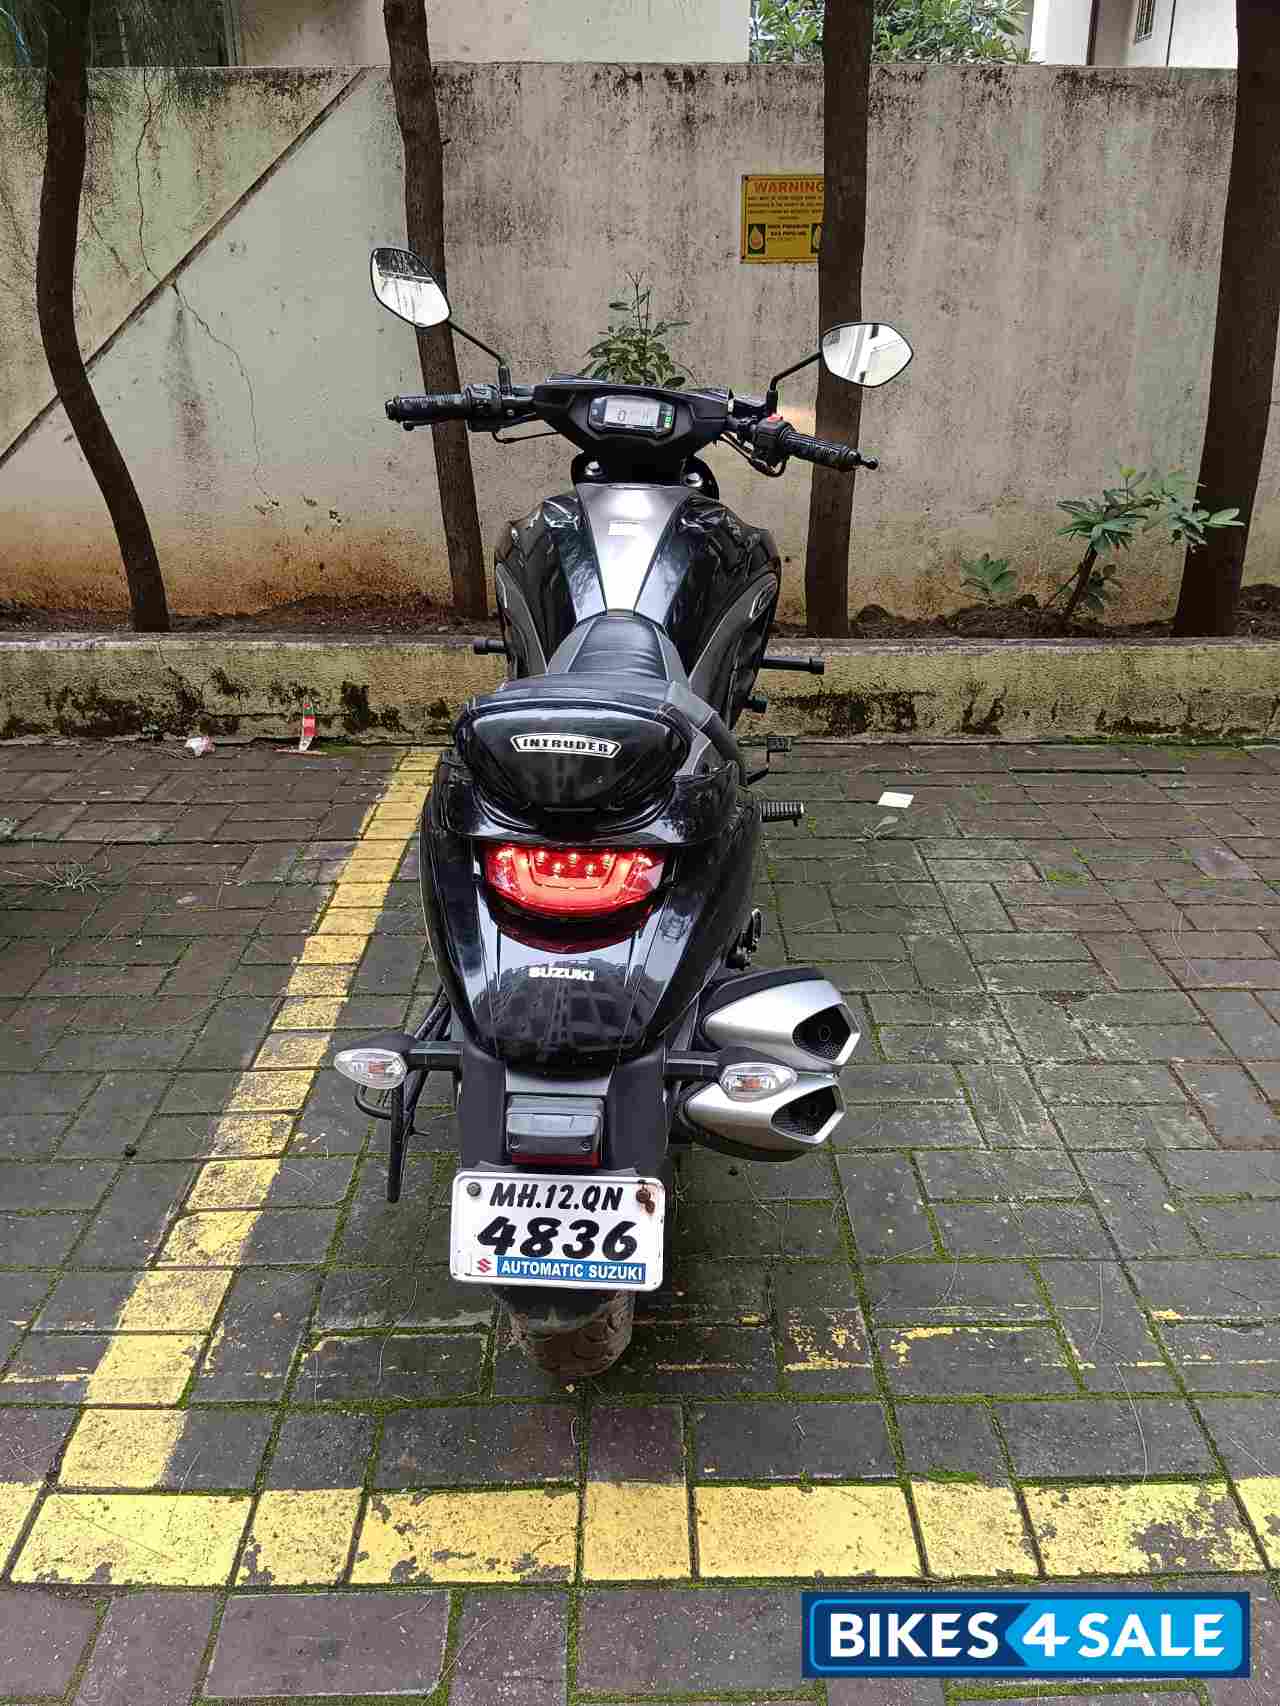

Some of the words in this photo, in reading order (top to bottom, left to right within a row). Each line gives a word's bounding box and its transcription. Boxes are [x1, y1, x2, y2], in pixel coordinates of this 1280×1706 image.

[752, 182, 825, 193] WARNING
[522, 738, 609, 753] INTRUDER
[528, 966, 595, 982] SUZUKI
[489, 1182, 624, 1213] MH.12.QN
[477, 1216, 638, 1262] 4836
[500, 1260, 584, 1278] AUTOMATIC
[589, 1263, 643, 1281] SUZUKI
